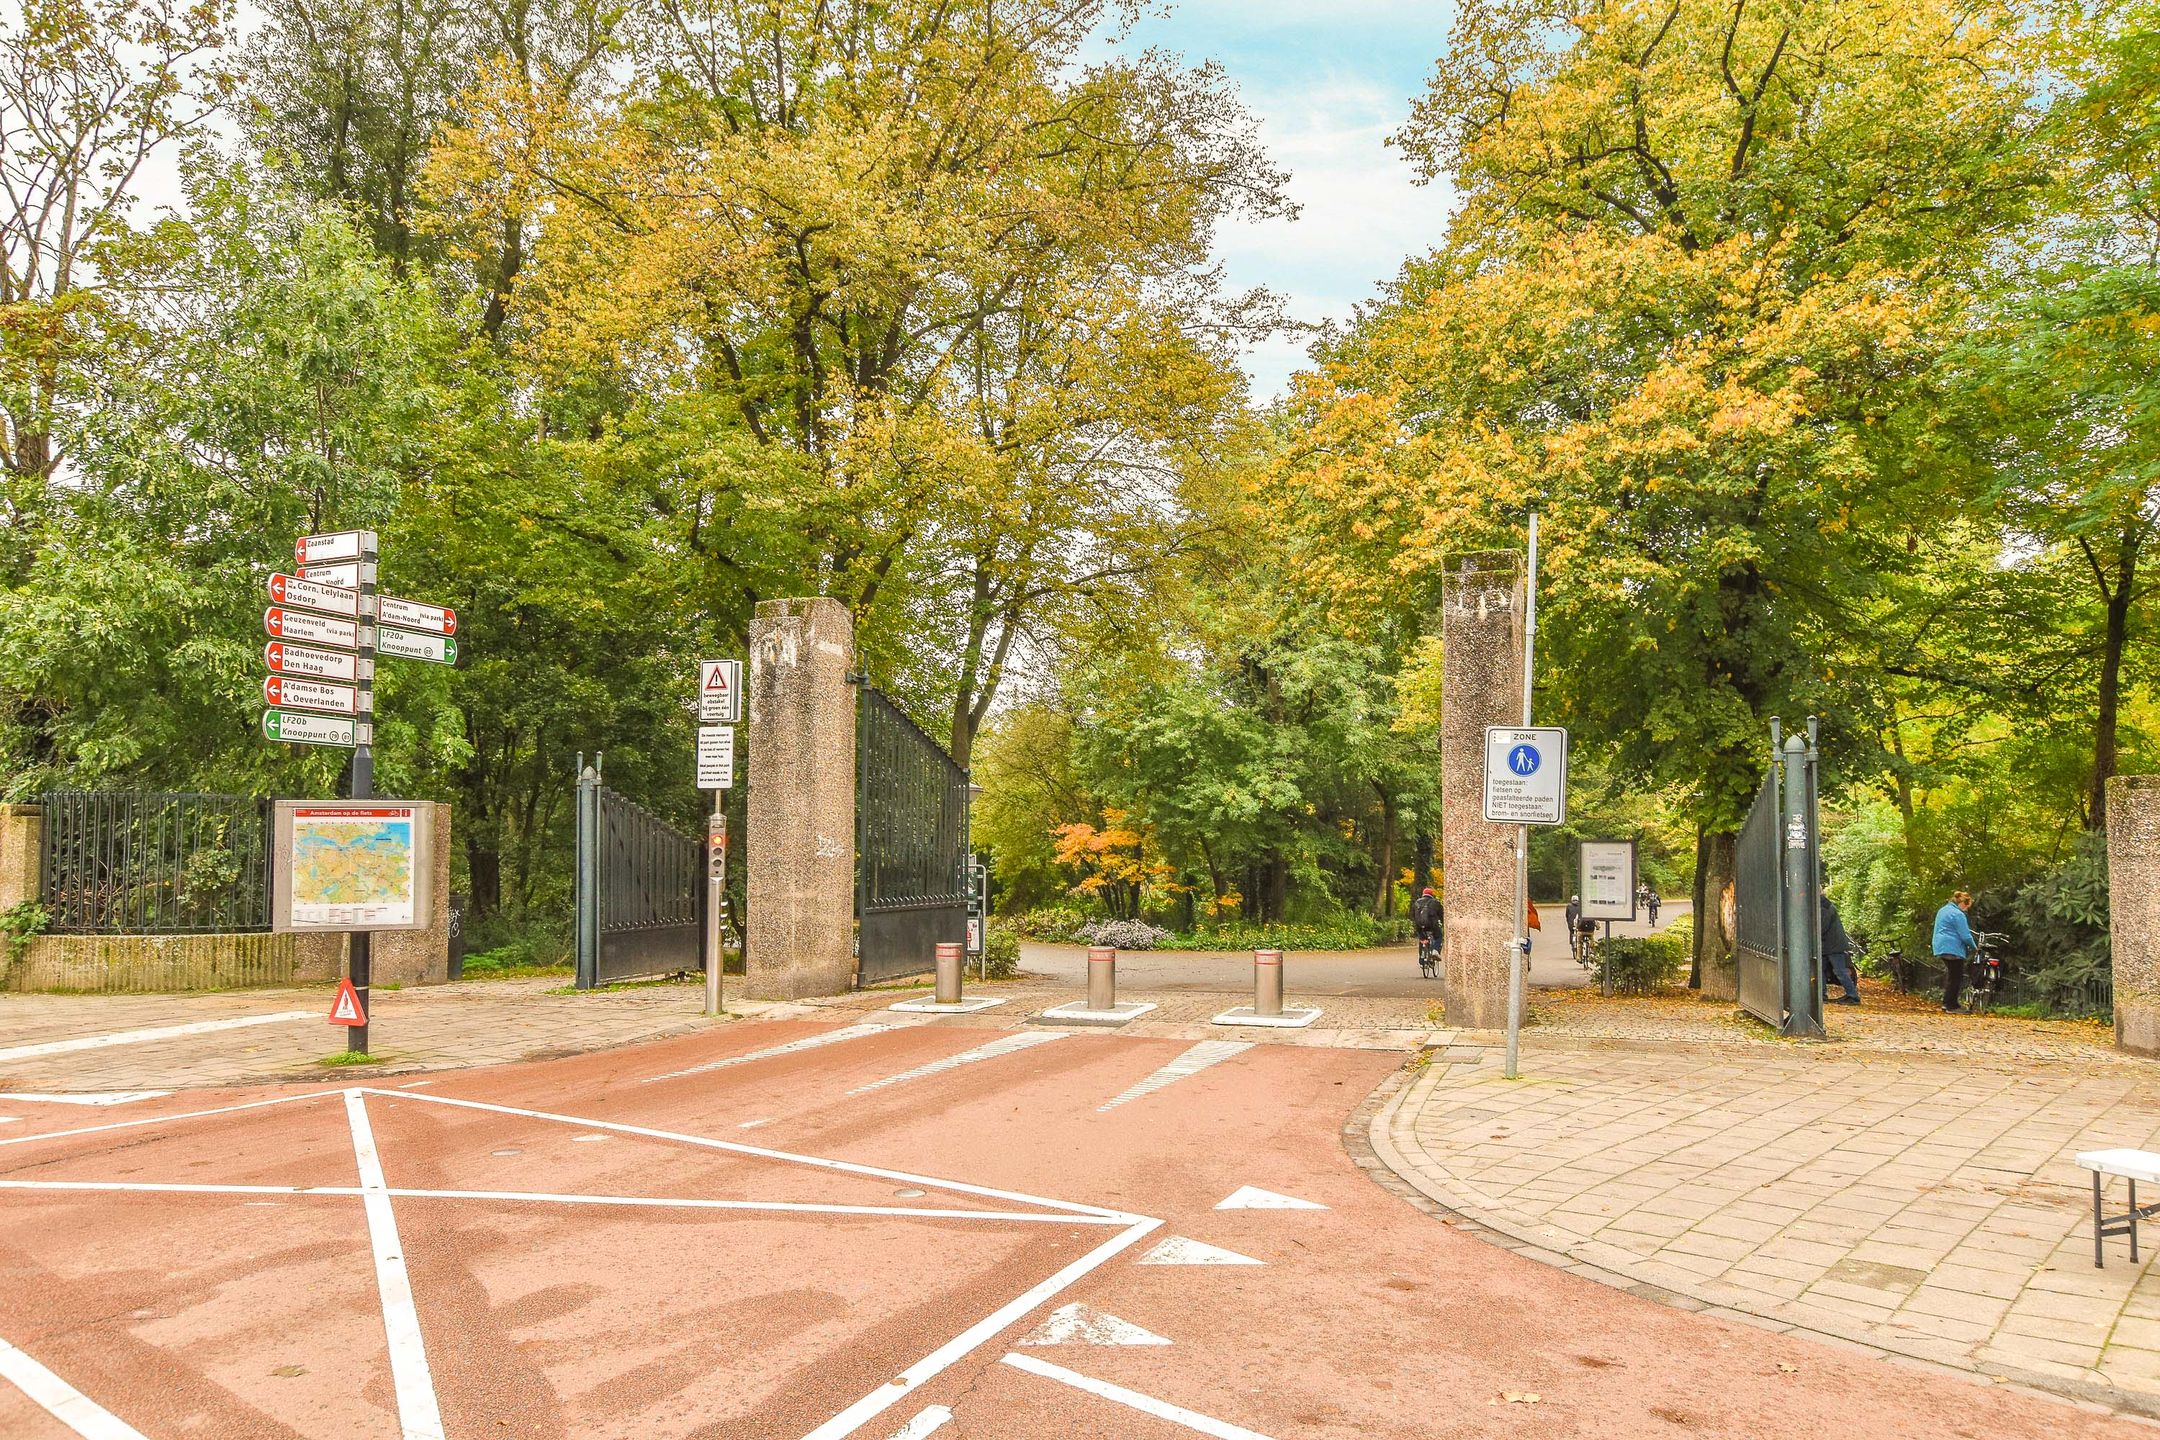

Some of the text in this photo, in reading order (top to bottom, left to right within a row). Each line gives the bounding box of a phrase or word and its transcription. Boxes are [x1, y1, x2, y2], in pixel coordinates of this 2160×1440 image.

[307, 538, 334, 548] Zaanstad
[306, 570, 332, 578] Centrum
[298, 582, 354, 600] Corn. Lelylaan
[286, 592, 316, 605] Osdorp
[382, 600, 408, 611] Centrum
[284, 614, 326, 628] Geuzenveld
[382, 611, 420, 624] A'dam-Noord
[284, 626, 314, 637] Haarlem
[382, 630, 404, 640] LF20a
[382, 642, 422, 654] Knooppunt
[284, 648, 343, 664] Badhoevedorp
[284, 660, 324, 674] Den Haag
[283, 682, 334, 695] A'damse Bos
[293, 695, 345, 708] Oeverlanden
[282, 716, 307, 725] LF20b
[282, 728, 326, 739] Knooppunt
[1514, 733, 1537, 741] ZONE
[1492, 794, 1533, 802] geasfalteerde
